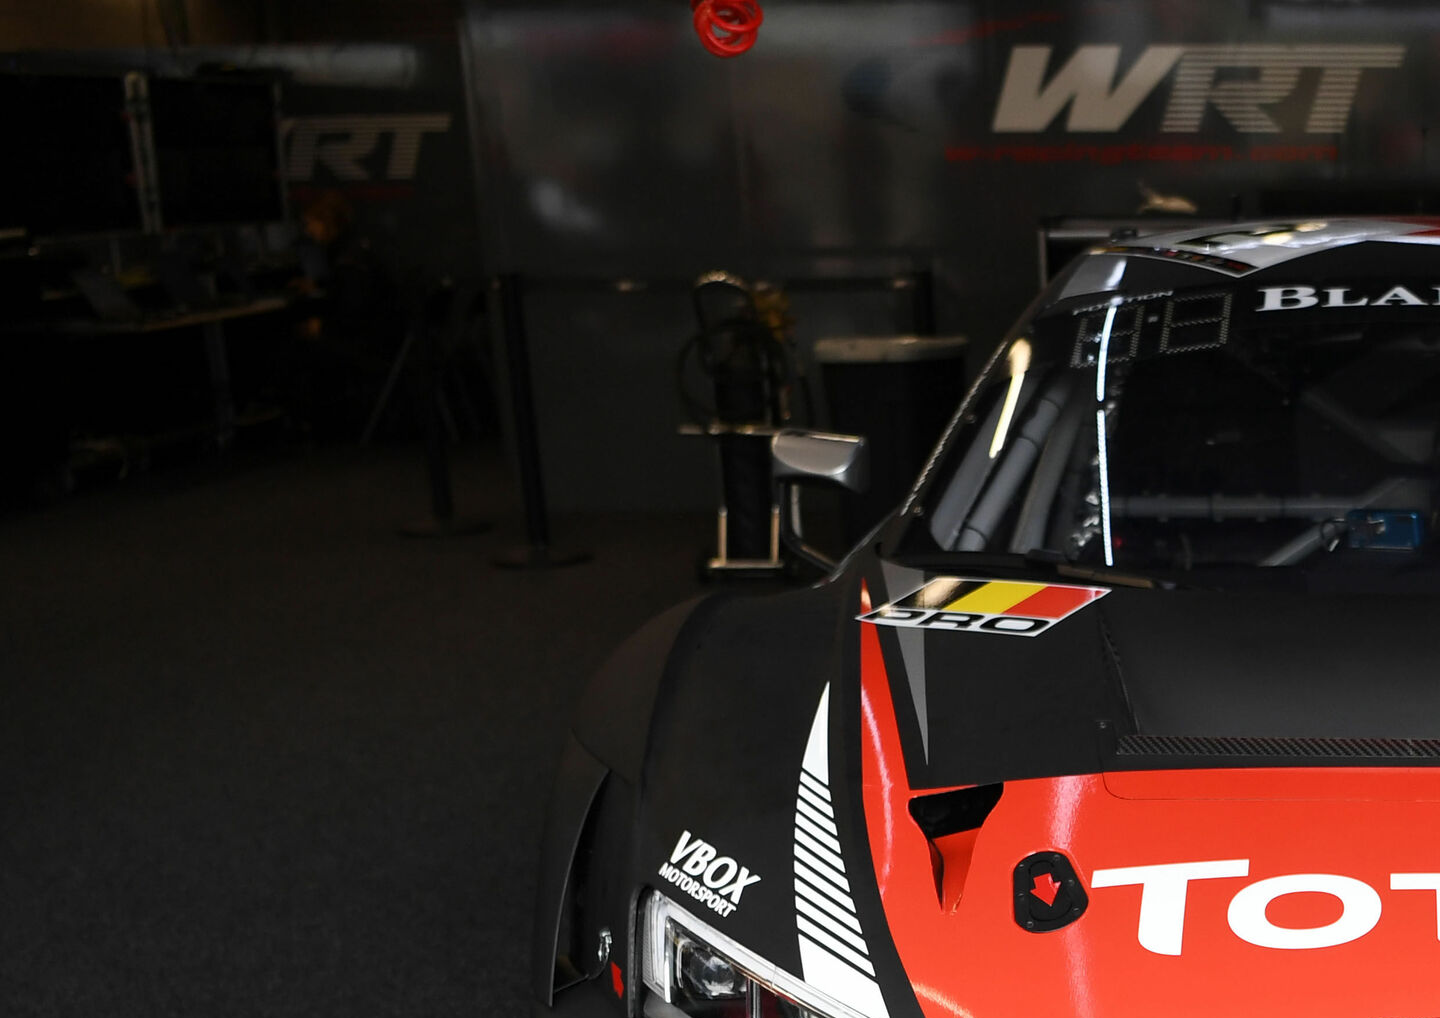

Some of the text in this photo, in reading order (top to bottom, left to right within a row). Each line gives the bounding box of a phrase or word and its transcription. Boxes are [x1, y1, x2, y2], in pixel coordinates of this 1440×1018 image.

[991, 44, 1406, 133] WRT
[285, 113, 453, 181] RT
[861, 608, 1051, 633] PRO
[658, 862, 737, 917] MOTORSPORT
[670, 830, 761, 904] VBOX
